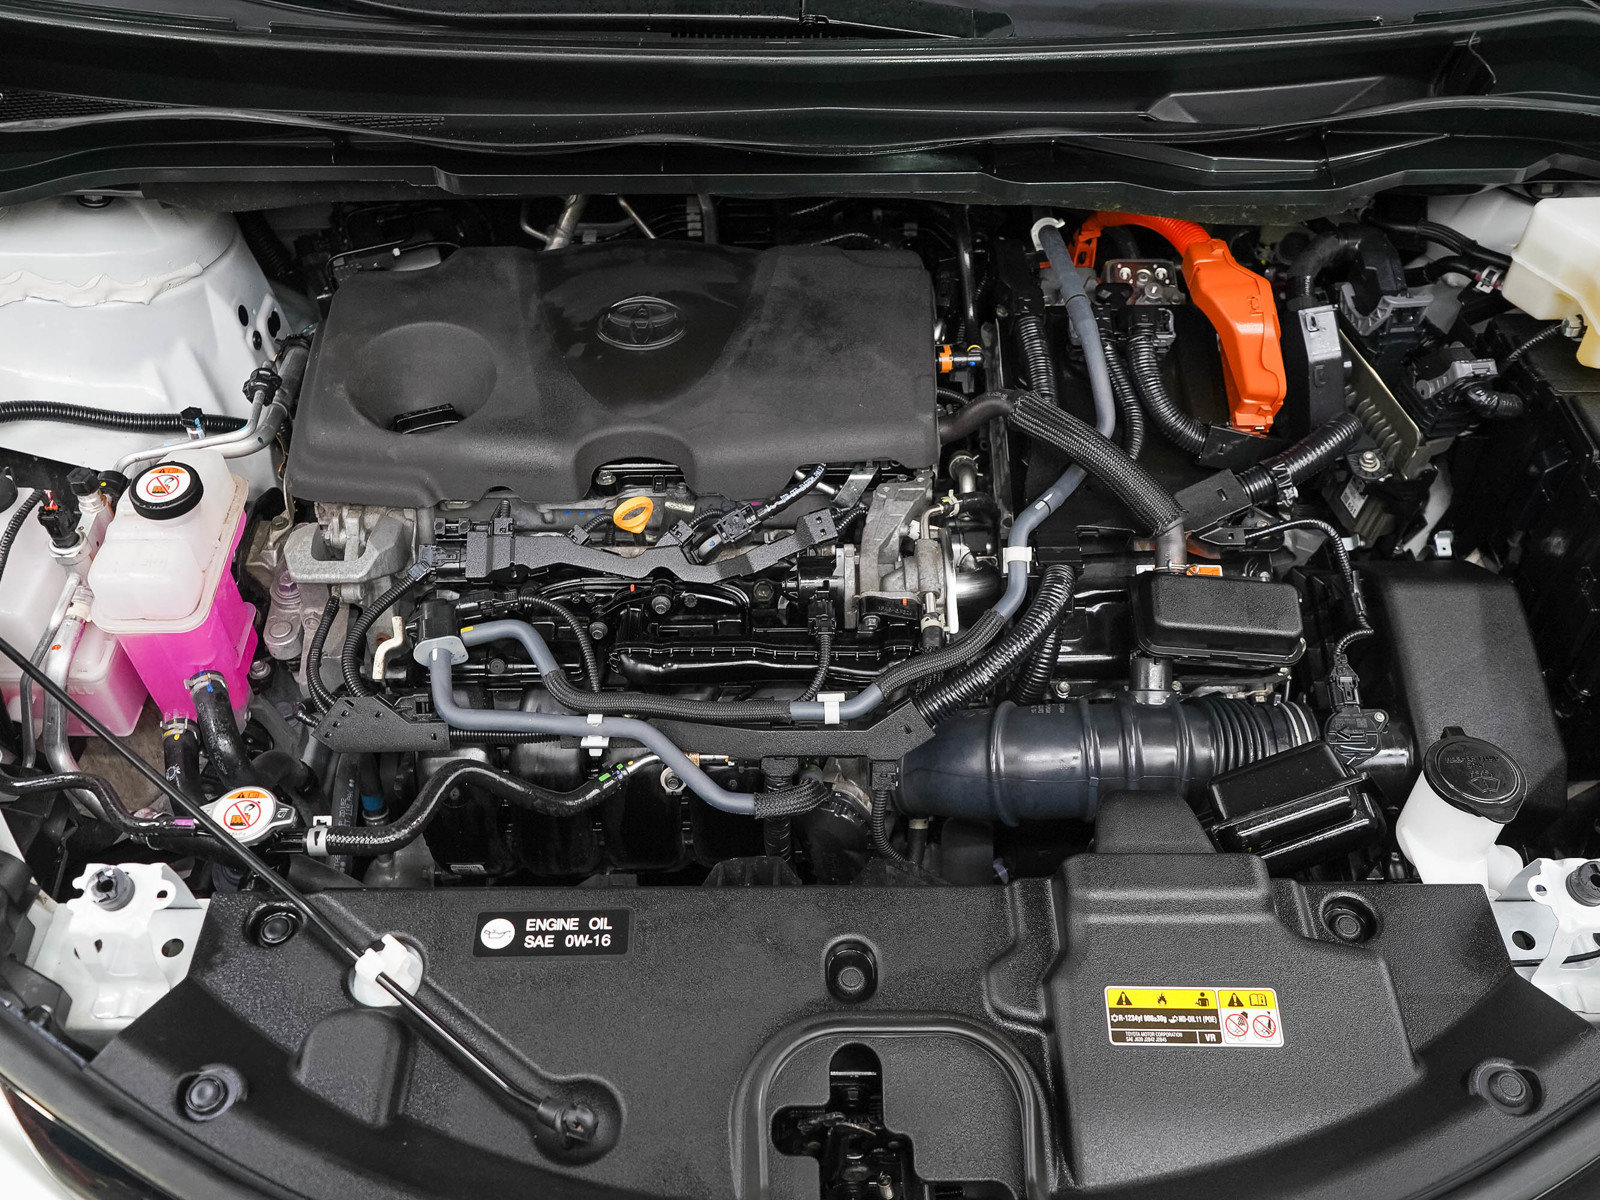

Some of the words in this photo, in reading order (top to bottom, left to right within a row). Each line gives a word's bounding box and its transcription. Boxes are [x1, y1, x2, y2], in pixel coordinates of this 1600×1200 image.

[525, 918, 579, 931] ENGINE
[588, 917, 612, 930] OIL
[524, 935, 554, 948] SAE
[565, 934, 611, 947] 0W-16
[1204, 1033, 1216, 1042] VR
